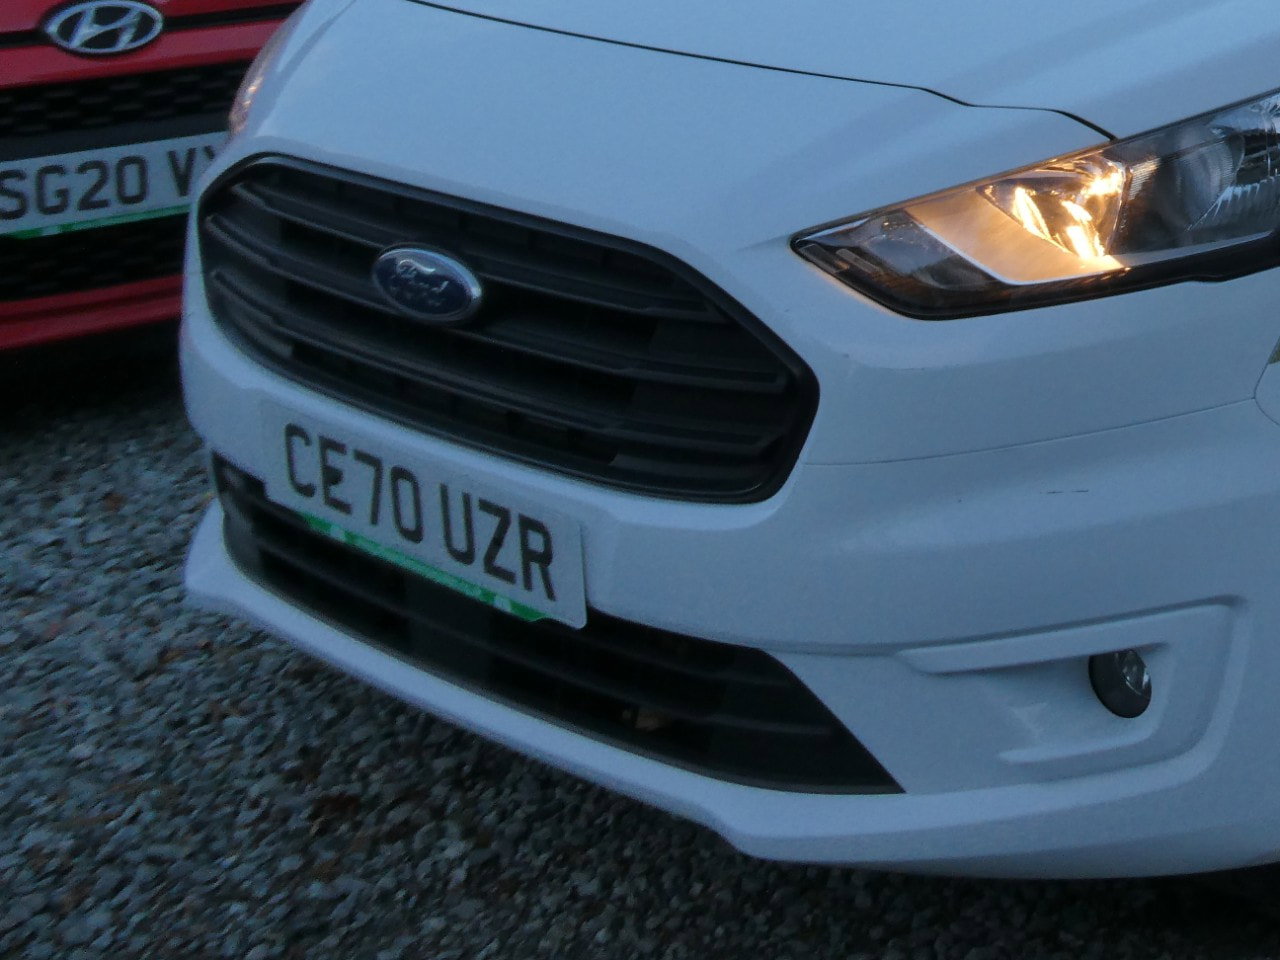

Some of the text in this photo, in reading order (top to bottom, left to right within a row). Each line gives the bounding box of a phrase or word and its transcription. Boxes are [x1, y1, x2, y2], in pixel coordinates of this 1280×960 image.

[0, 144, 216, 221] SG20 V
[284, 422, 557, 603] CE70 UZR
